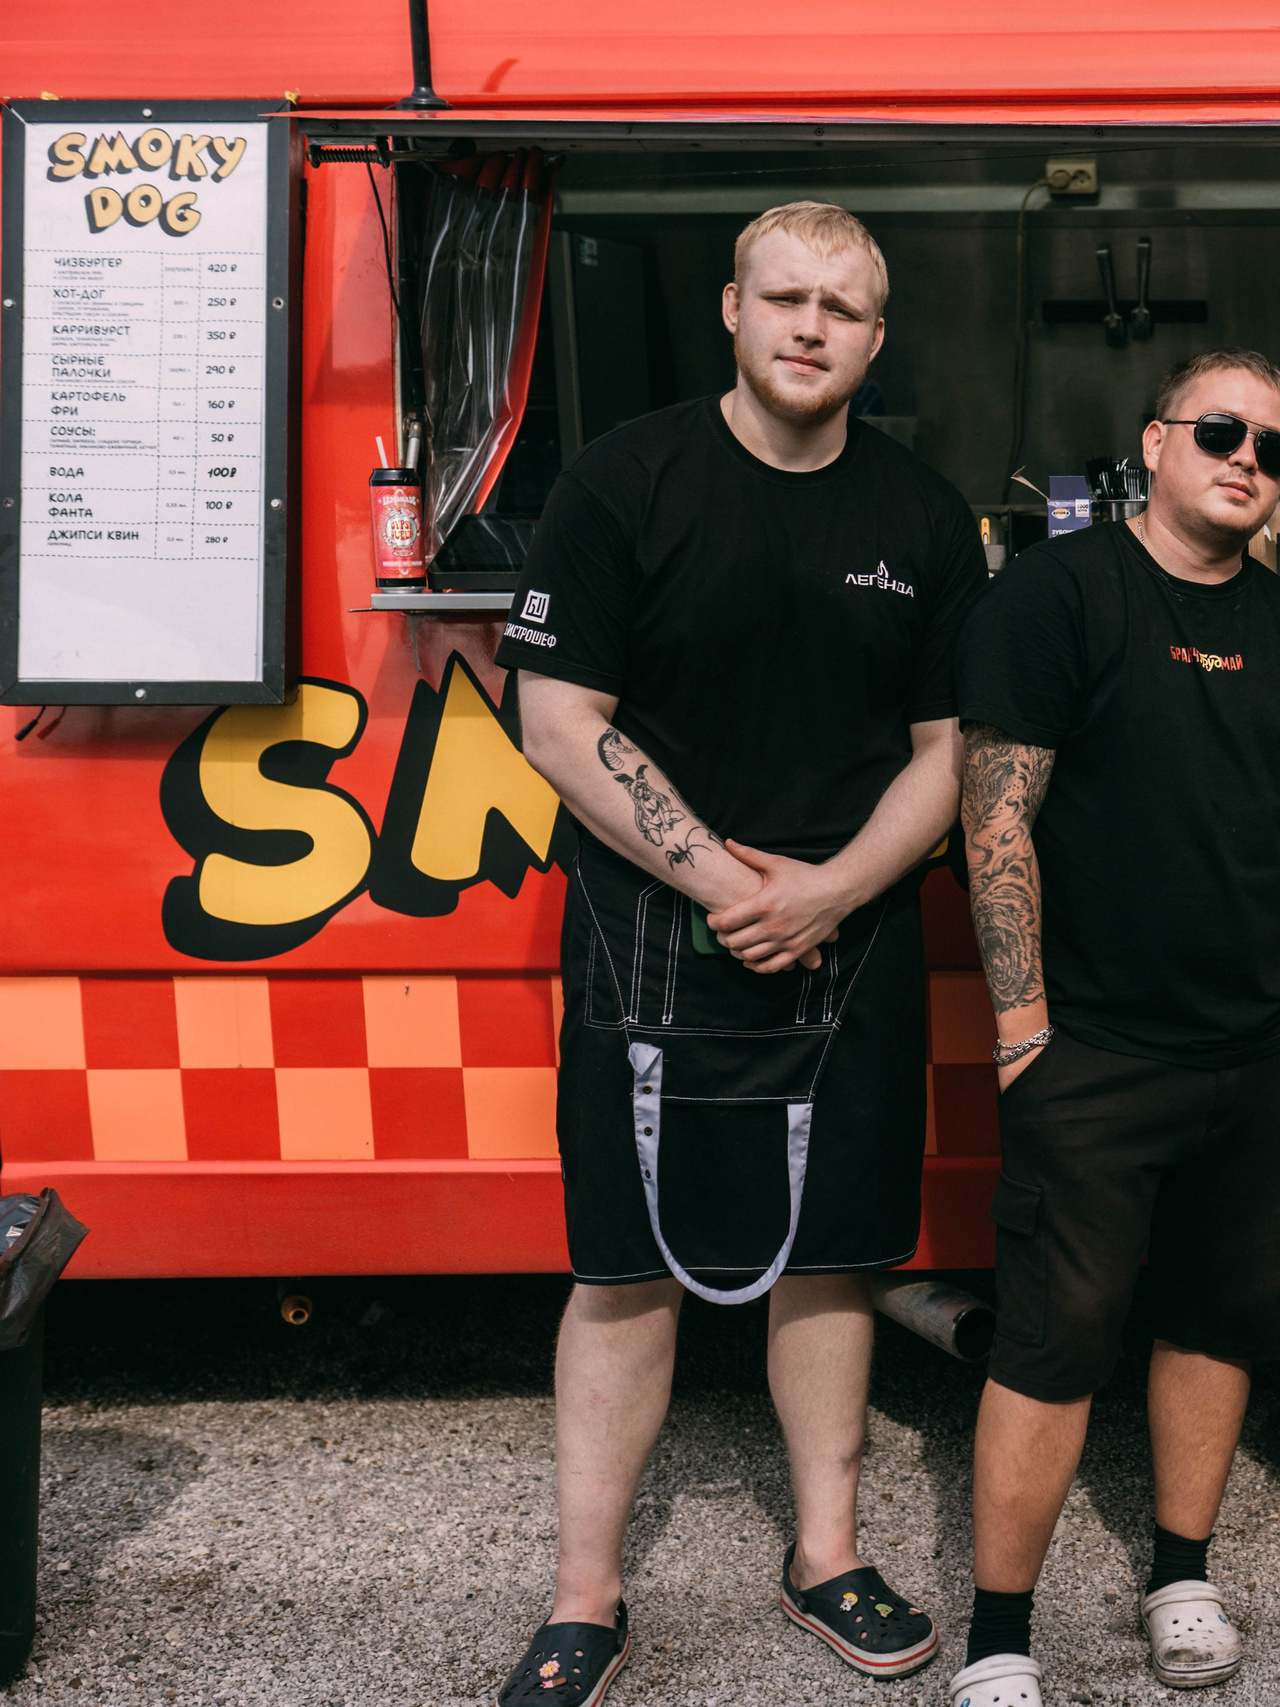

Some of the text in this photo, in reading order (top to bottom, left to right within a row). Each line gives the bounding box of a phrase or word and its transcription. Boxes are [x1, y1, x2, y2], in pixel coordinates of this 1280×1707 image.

[47, 127, 247, 183] SMOKY
[84, 183, 202, 237] DOG
[54, 257, 122, 267] ЧИЗБУРГЕР
[207, 263, 228, 273] 420
[53, 289, 105, 300] ХОТ-ДОГ
[207, 297, 227, 307] 250
[52, 325, 131, 335] КАРРИВУРСТ
[206, 331, 226, 340] 350
[52, 355, 105, 366] СЫРНЫЕ
[52, 367, 111, 378] ПАЛОЧКИ
[205, 365, 226, 374] 290
[51, 391, 126, 402] КАРТОФЕЛЬ
[207, 400, 225, 409] 160
[50, 405, 78, 416] ФРИ
[50, 426, 96, 436] СОУСЫ:
[211, 433, 225, 442] 50
[49, 466, 84, 478] ВОДА
[48, 493, 83, 503] КОЛА
[205, 501, 223, 510] 100
[48, 507, 93, 517] ФАНТА
[391, 519, 412, 530] GYPSY
[47, 529, 139, 541] ДЖИПСИ КВИН
[845, 572, 914, 598] ЛЕГЕНДА
